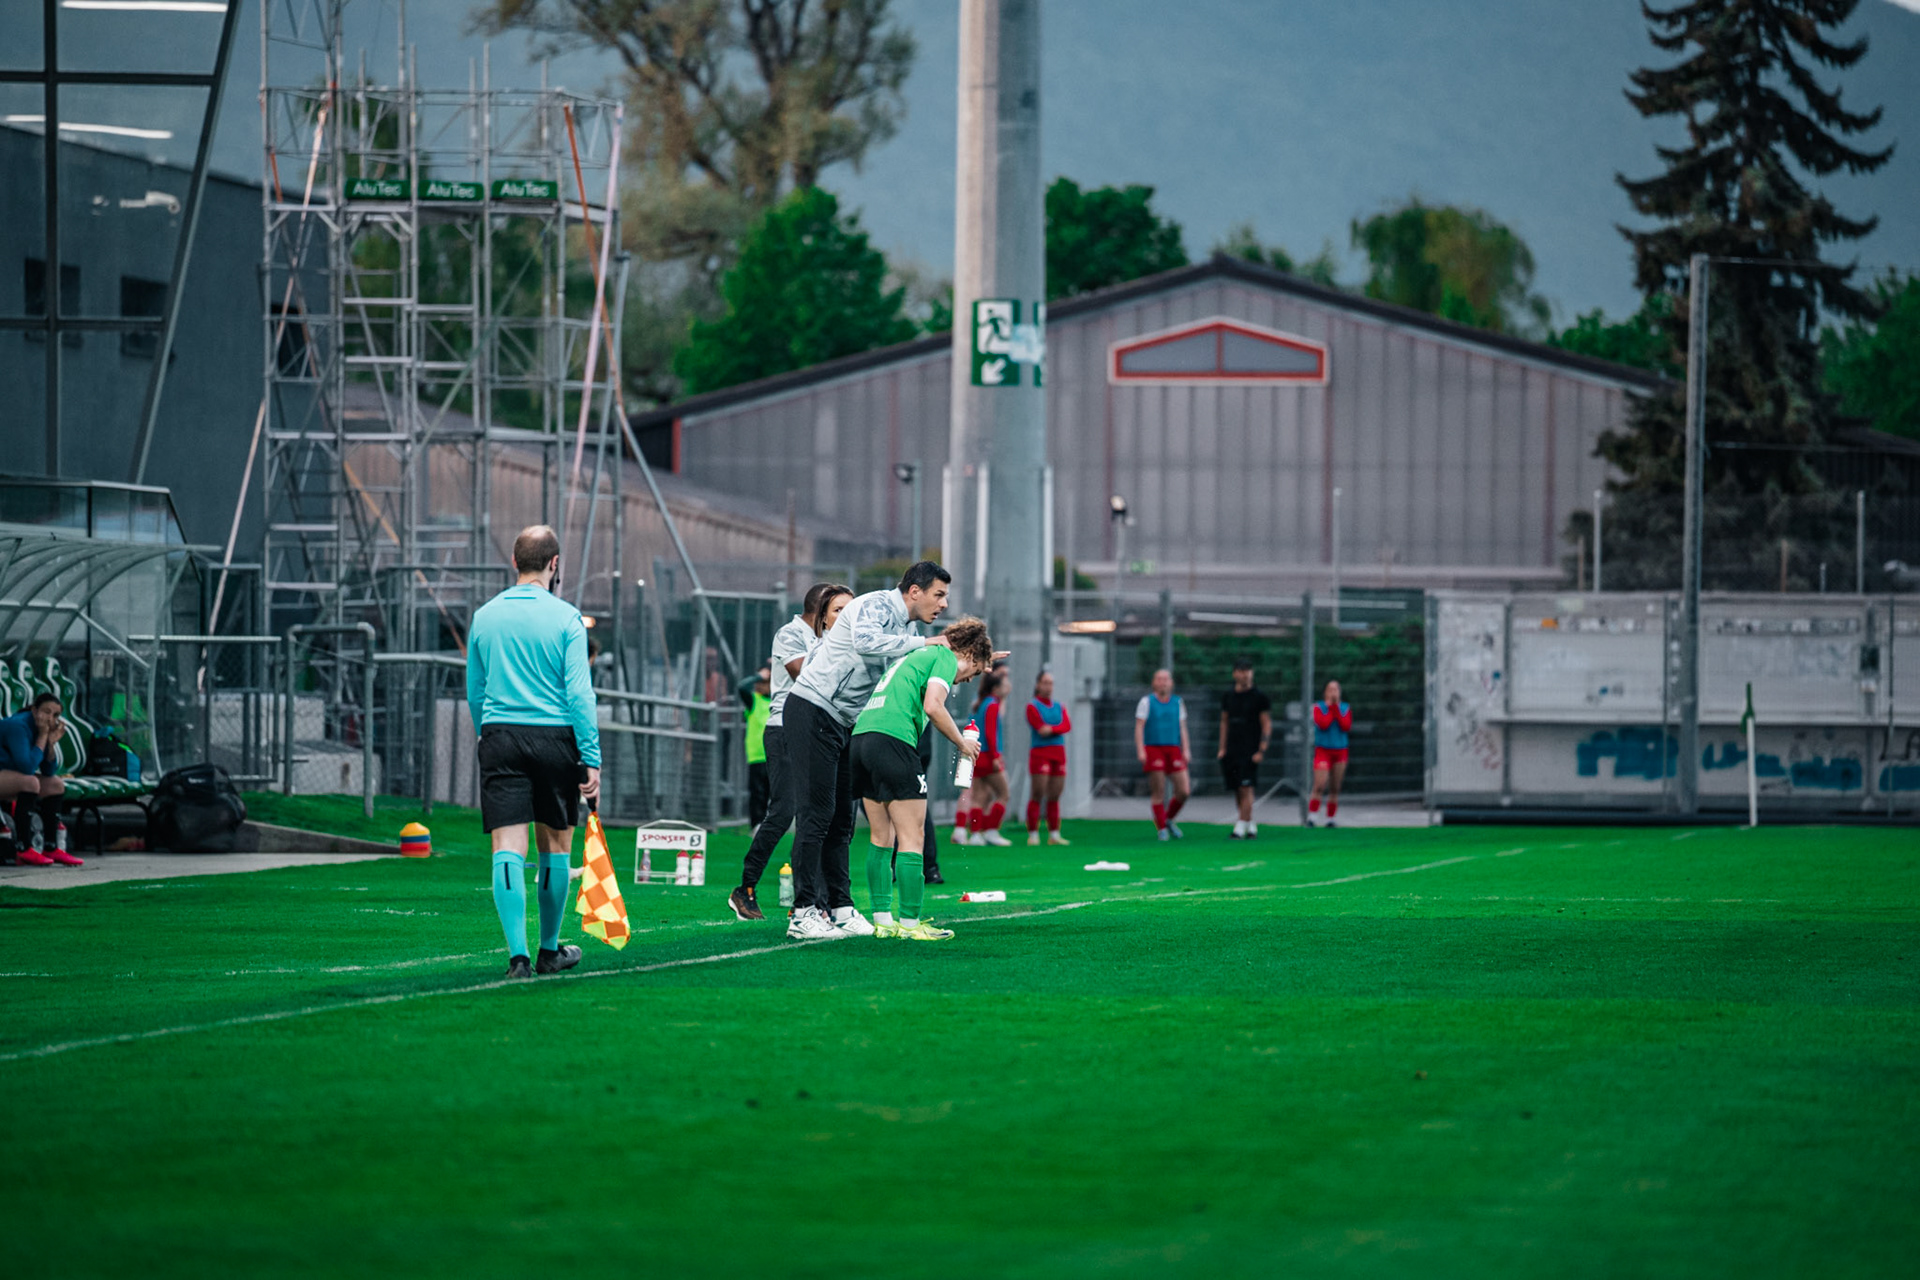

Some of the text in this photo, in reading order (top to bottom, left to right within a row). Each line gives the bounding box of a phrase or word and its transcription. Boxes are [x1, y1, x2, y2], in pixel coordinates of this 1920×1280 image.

[352, 181, 402, 197] AluTec
[426, 182, 476, 199] AluTec
[500, 181, 550, 198] AluTec
[641, 834, 686, 844] SPONSER
